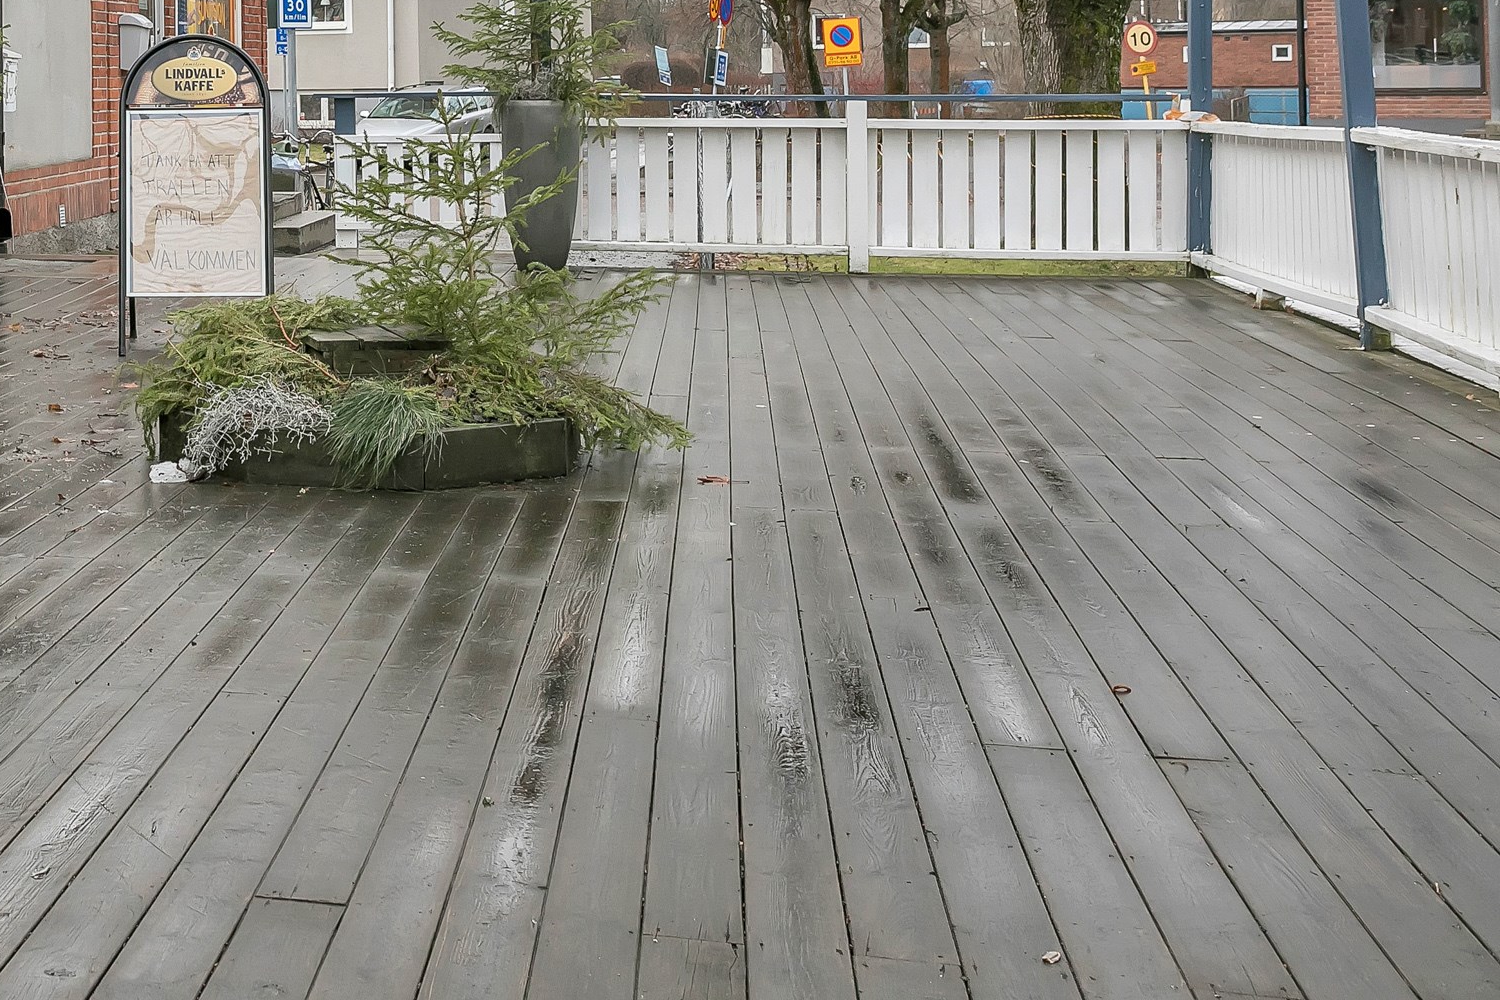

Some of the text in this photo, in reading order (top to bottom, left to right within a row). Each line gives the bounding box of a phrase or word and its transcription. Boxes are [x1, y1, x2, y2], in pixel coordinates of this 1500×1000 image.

[286, 0, 305, 12] 30
[1130, 31, 1151, 47] 10
[174, 80, 214, 92] KAFFE
[207, 153, 235, 168] ATT
[142, 178, 230, 196] TRALLEN
